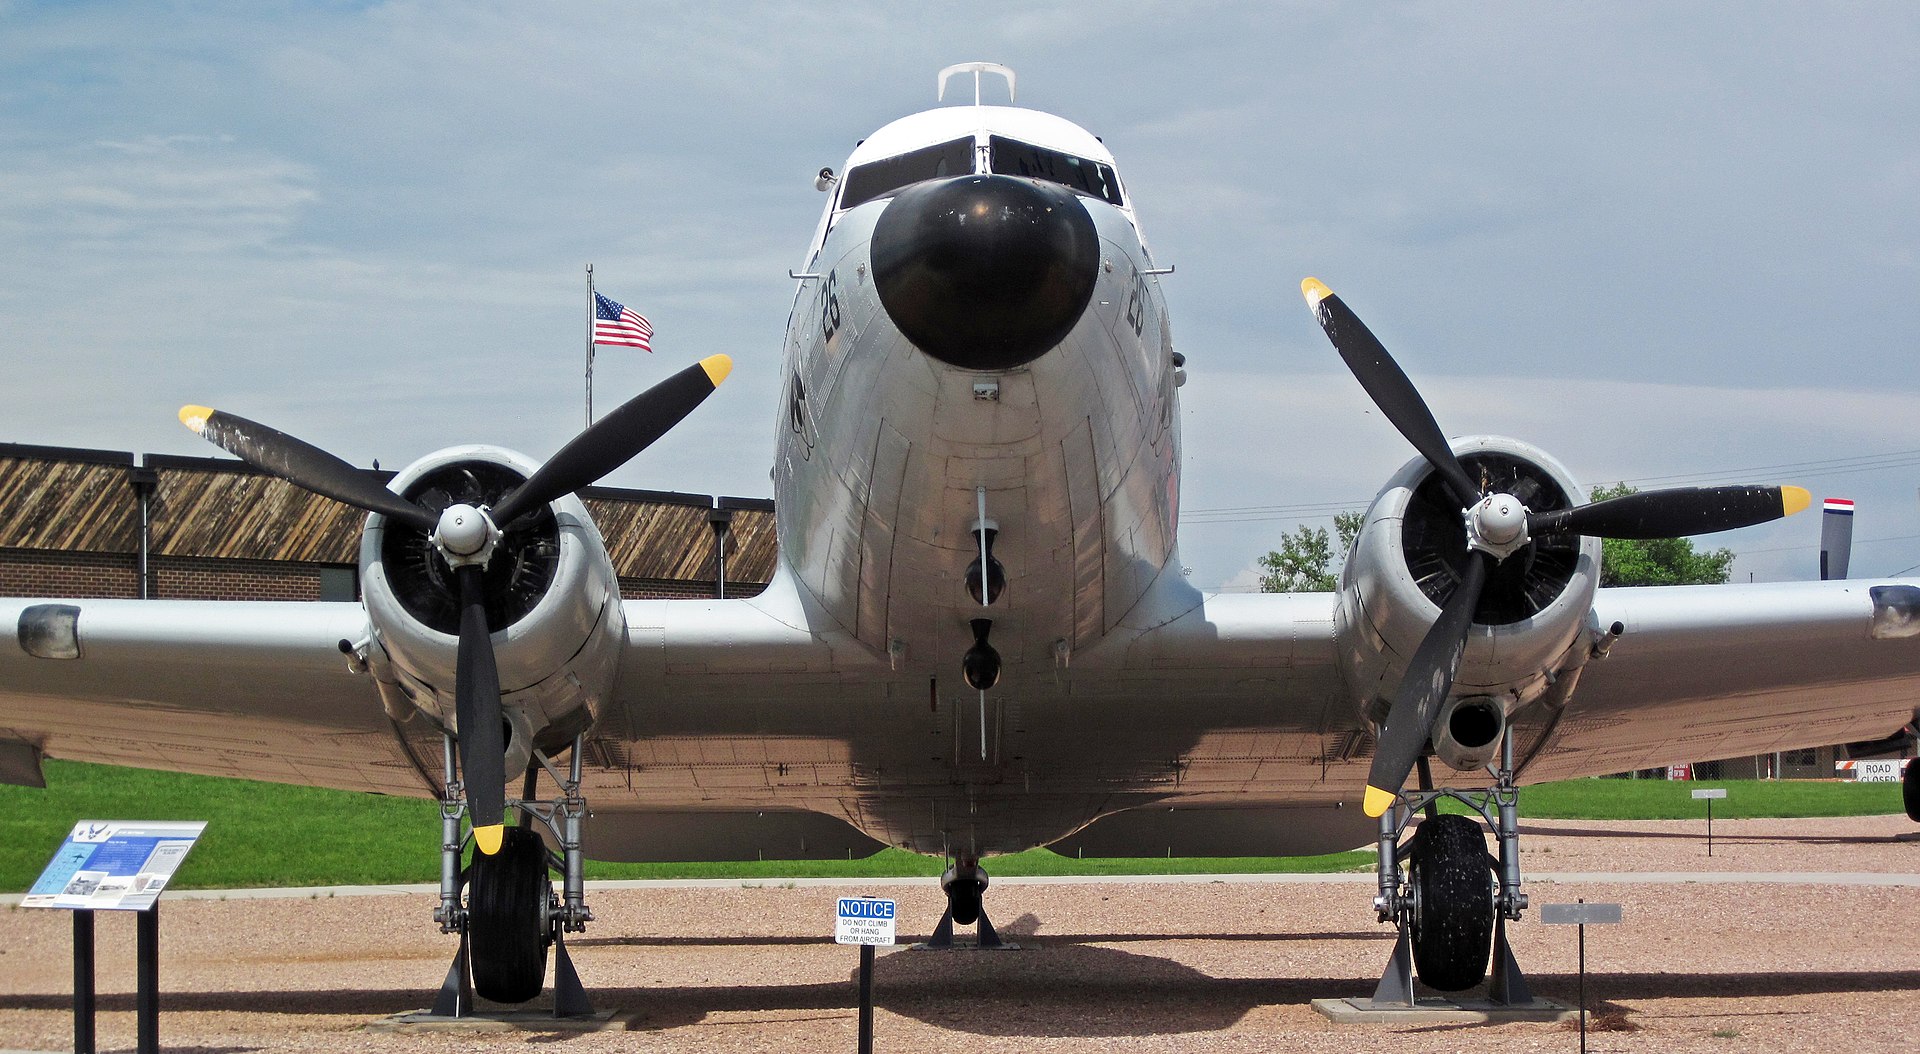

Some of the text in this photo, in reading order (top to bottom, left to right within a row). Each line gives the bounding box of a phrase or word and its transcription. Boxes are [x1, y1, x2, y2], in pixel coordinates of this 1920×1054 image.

[821, 268, 840, 344] 26
[1127, 266, 1144, 338] 26
[1866, 764, 1891, 773] ROAD
[840, 901, 893, 917] NOTICE
[861, 928, 879, 936] HANG
